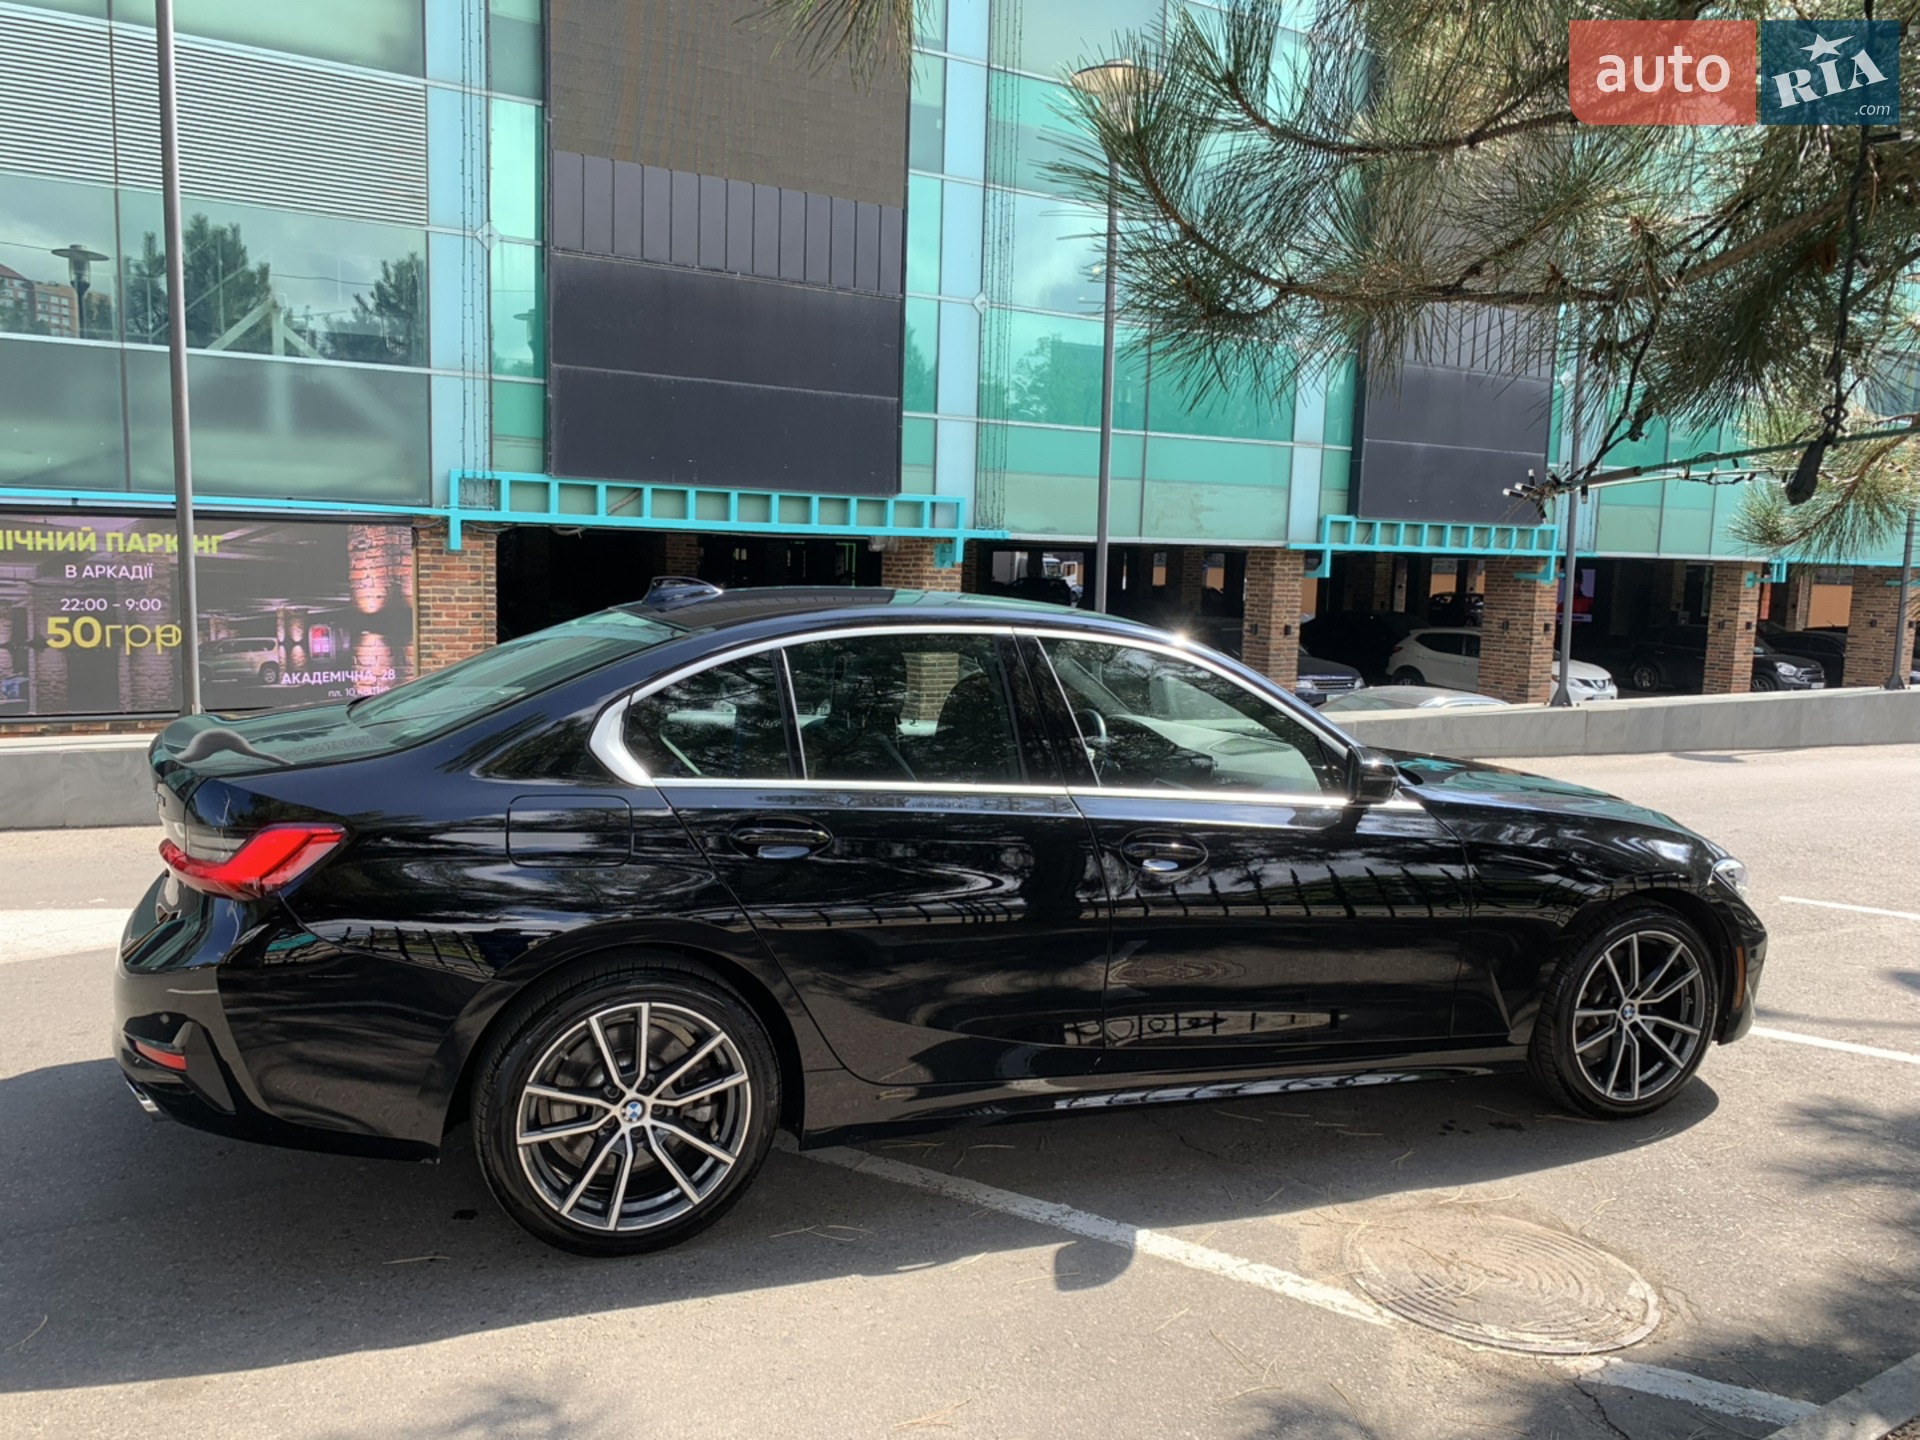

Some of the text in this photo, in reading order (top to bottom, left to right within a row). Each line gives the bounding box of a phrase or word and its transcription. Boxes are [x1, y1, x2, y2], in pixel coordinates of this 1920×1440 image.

[106, 532, 224, 555] ПАРКНГ
[65, 563, 154, 580] В АРКАДІЇ
[60, 598, 108, 612] 22:00
[125, 598, 161, 612] 9:00
[382, 668, 396, 680] 28
